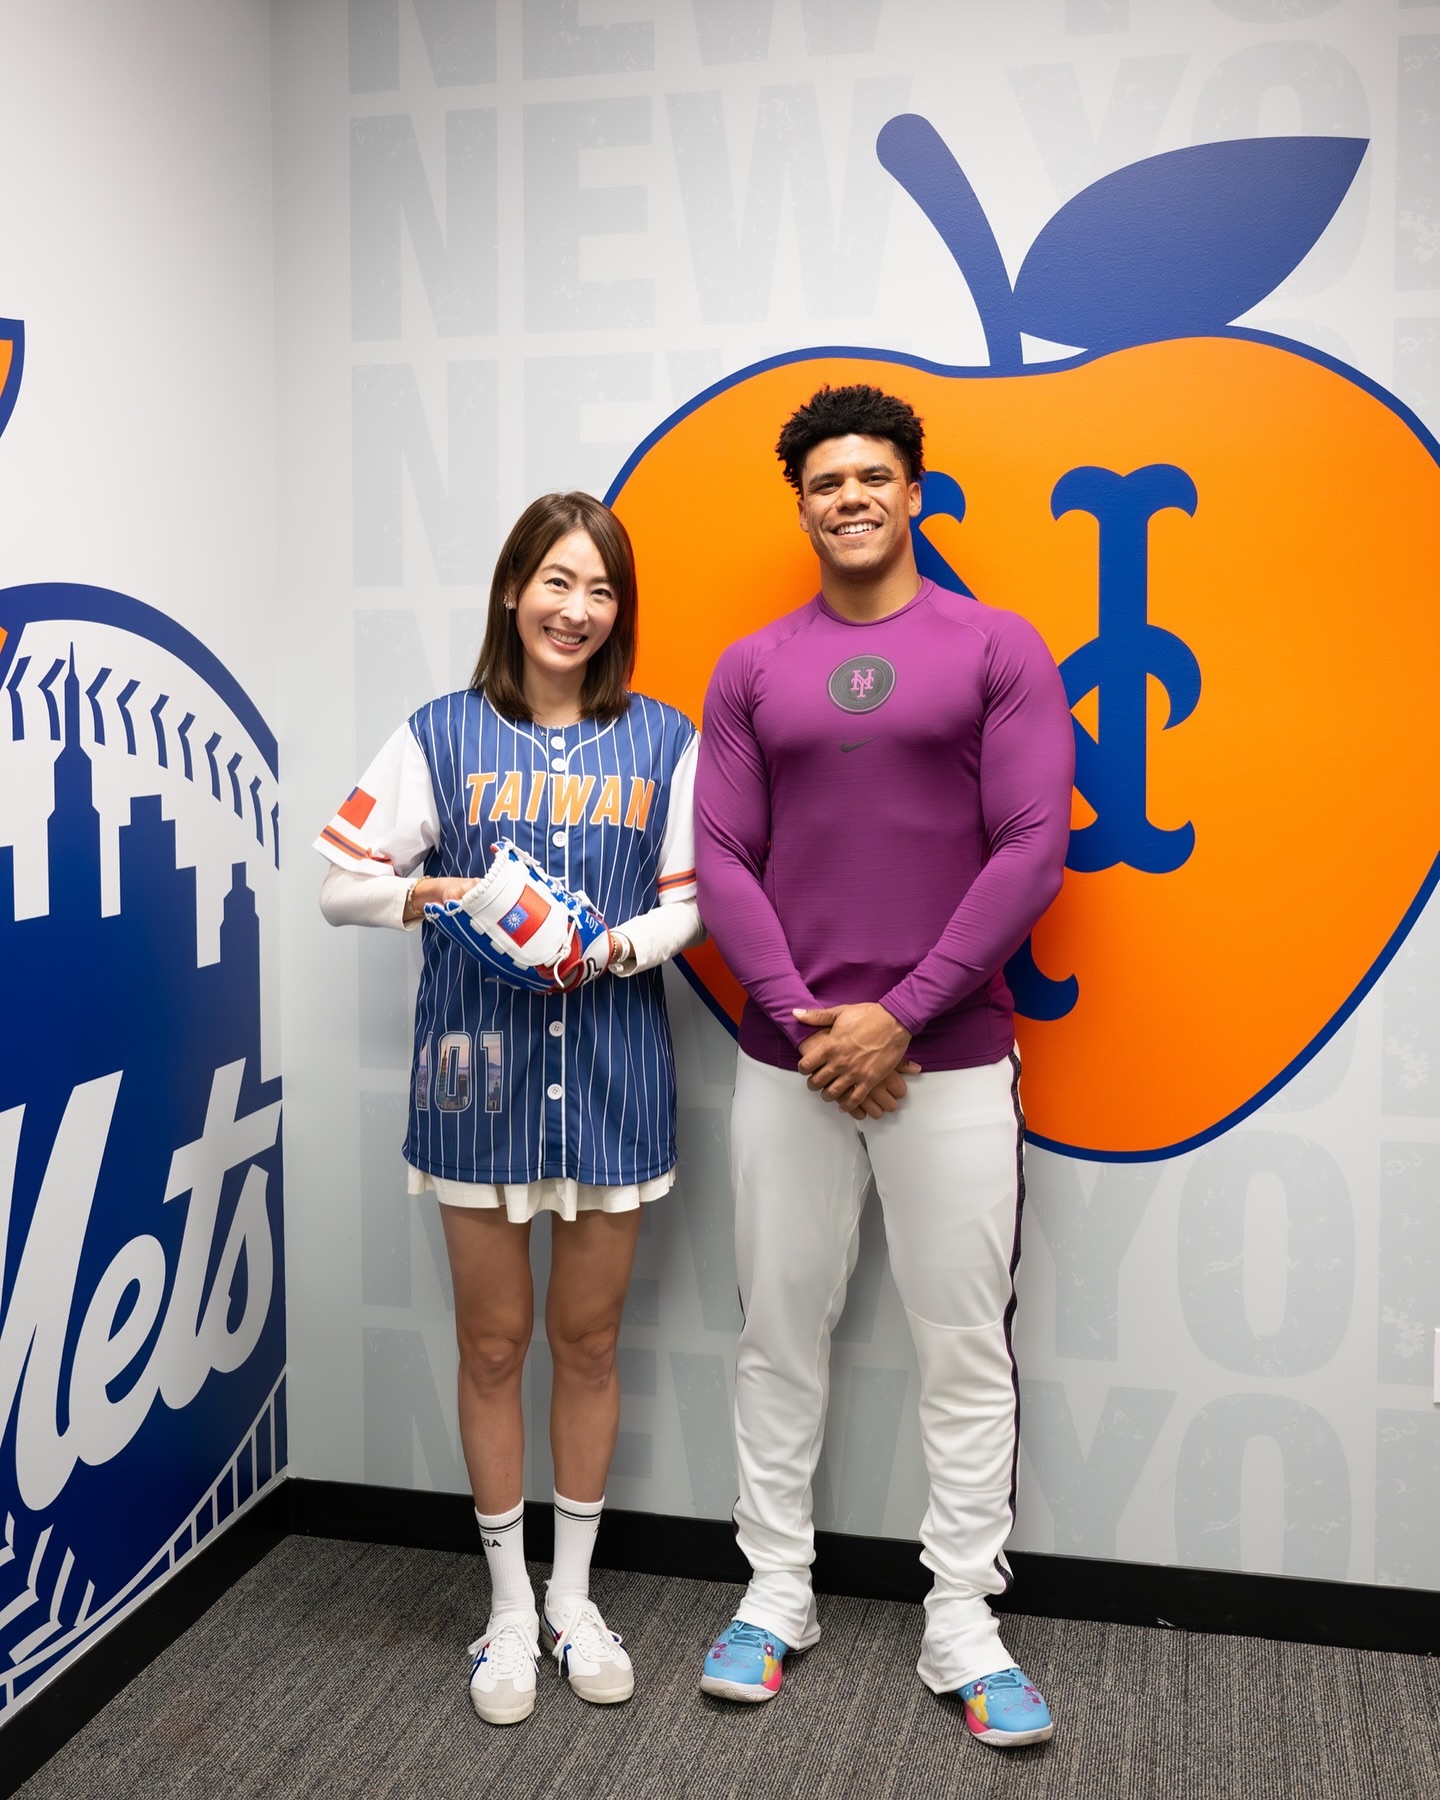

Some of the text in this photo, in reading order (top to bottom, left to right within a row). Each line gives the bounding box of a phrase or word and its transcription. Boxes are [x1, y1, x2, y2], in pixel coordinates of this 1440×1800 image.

[348, 75, 913, 342] NEW
[850, 668, 875, 698] NY
[466, 770, 655, 832] TAIWAN
[415, 1030, 503, 1113] 101
